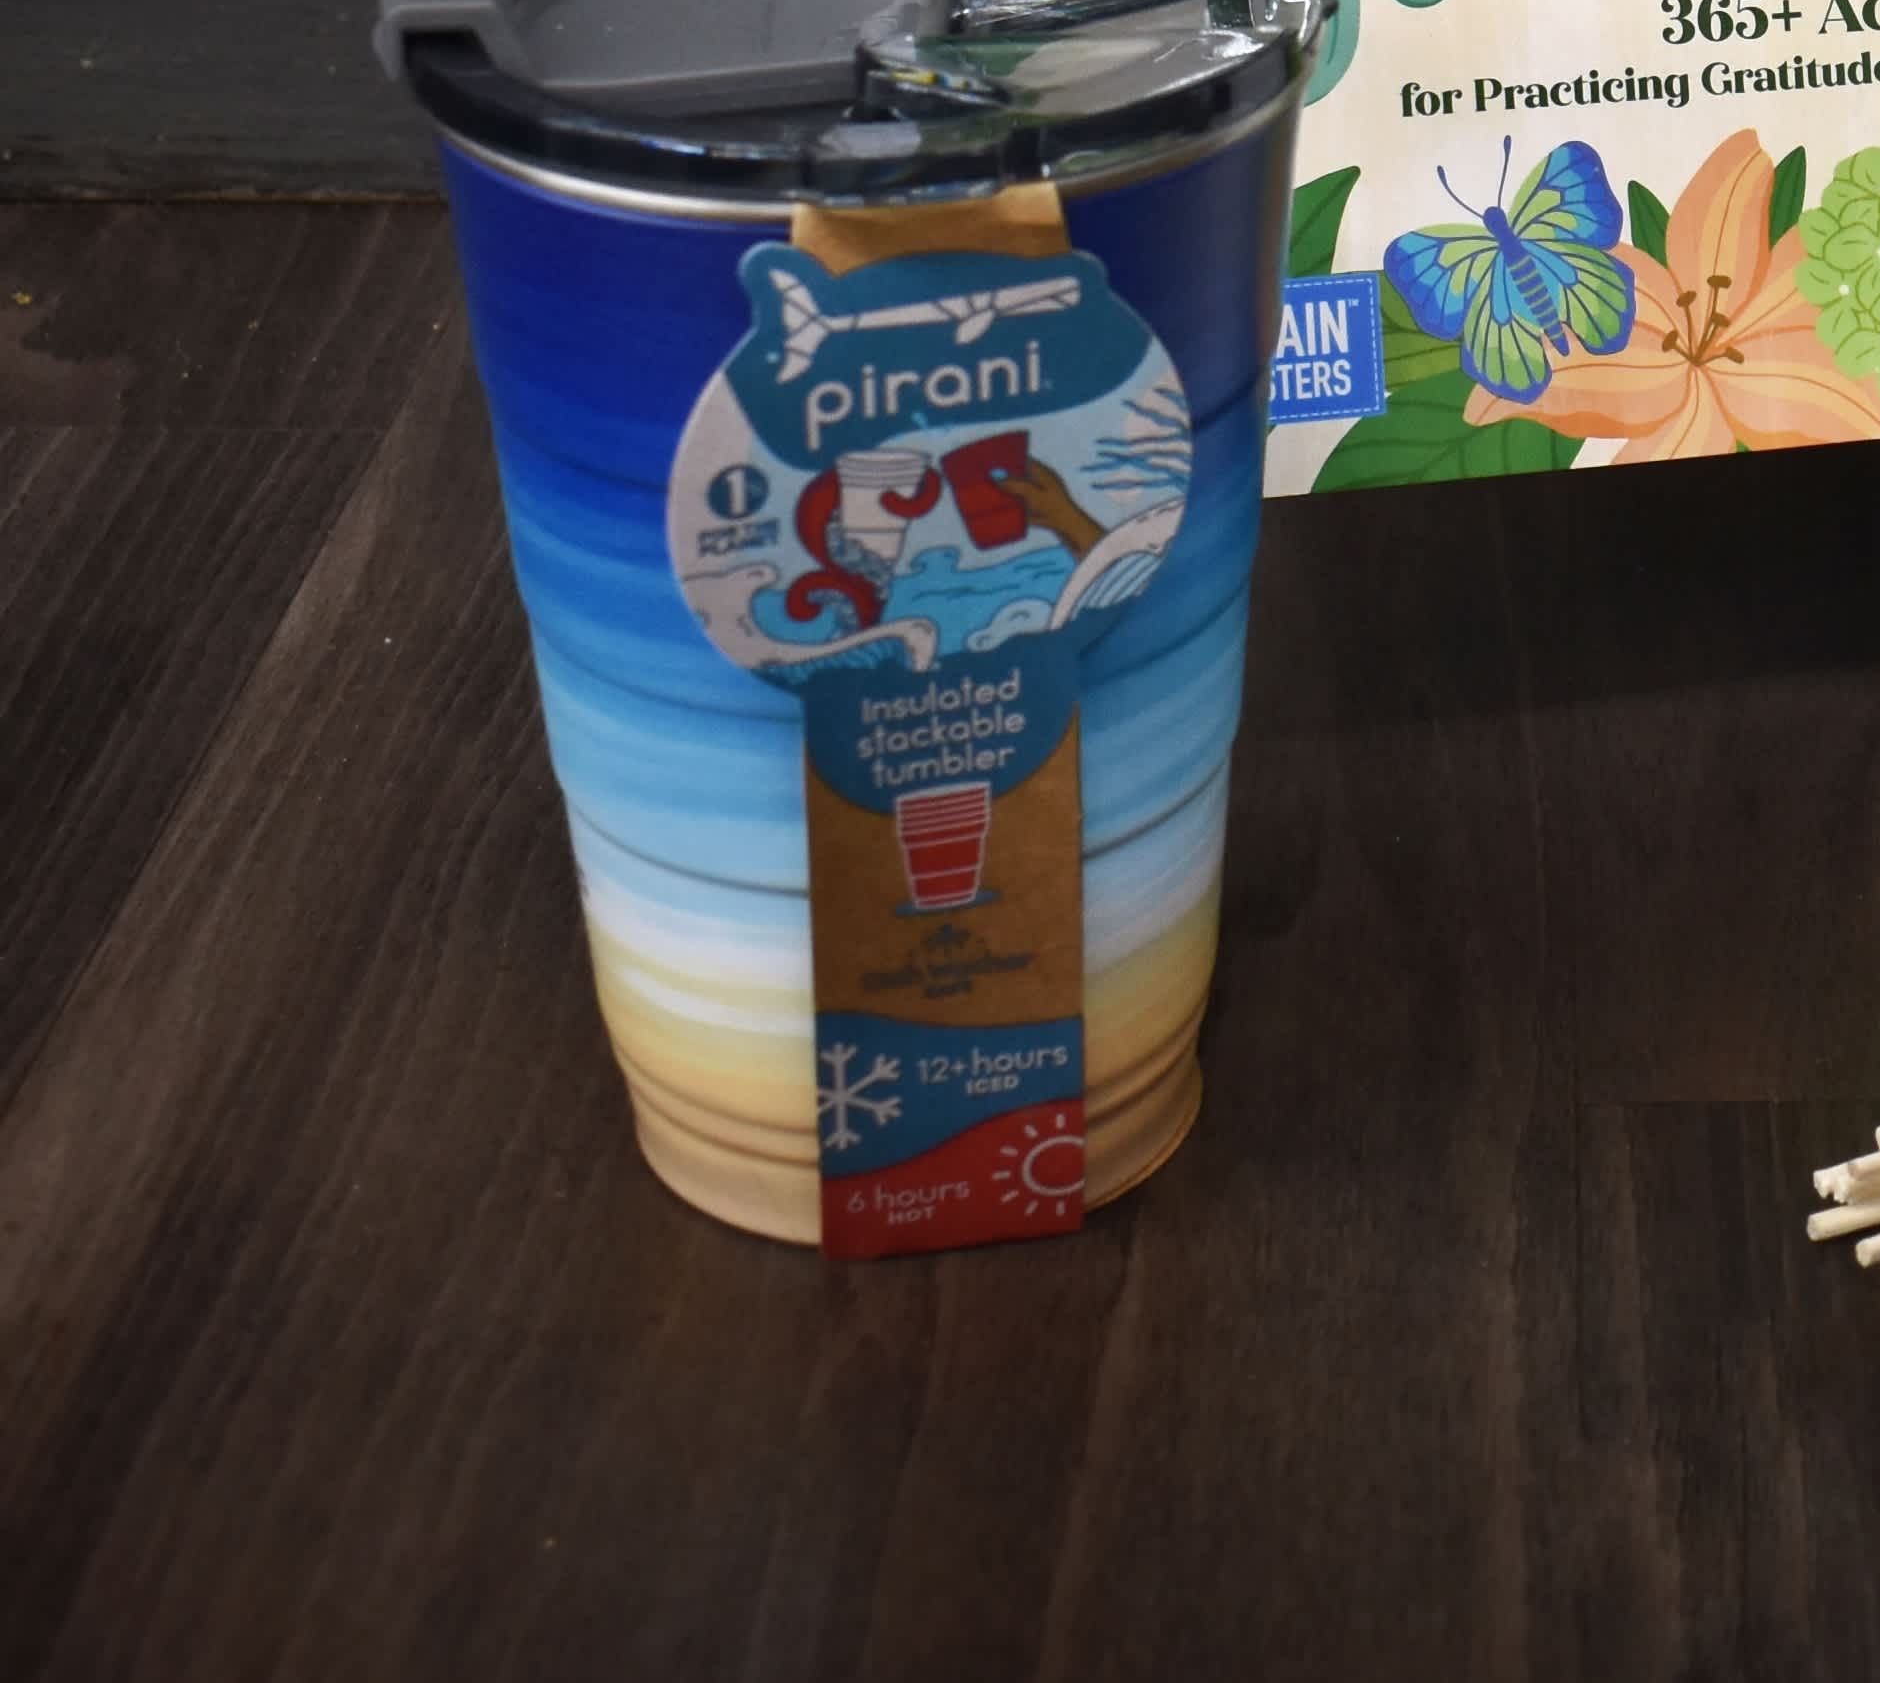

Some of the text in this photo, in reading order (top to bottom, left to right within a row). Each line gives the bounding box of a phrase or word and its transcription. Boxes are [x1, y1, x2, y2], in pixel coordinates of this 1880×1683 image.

[1400, 81, 1462, 117] for
[1474, 65, 1690, 113] Practicing
[805, 340, 1041, 451] pirani
[857, 705, 1026, 758] stackable
[872, 742, 1016, 789] tumbler
[966, 1074, 1019, 1096] ICED
[848, 1180, 970, 1213] 6 hours
[888, 1205, 936, 1226] HOT
